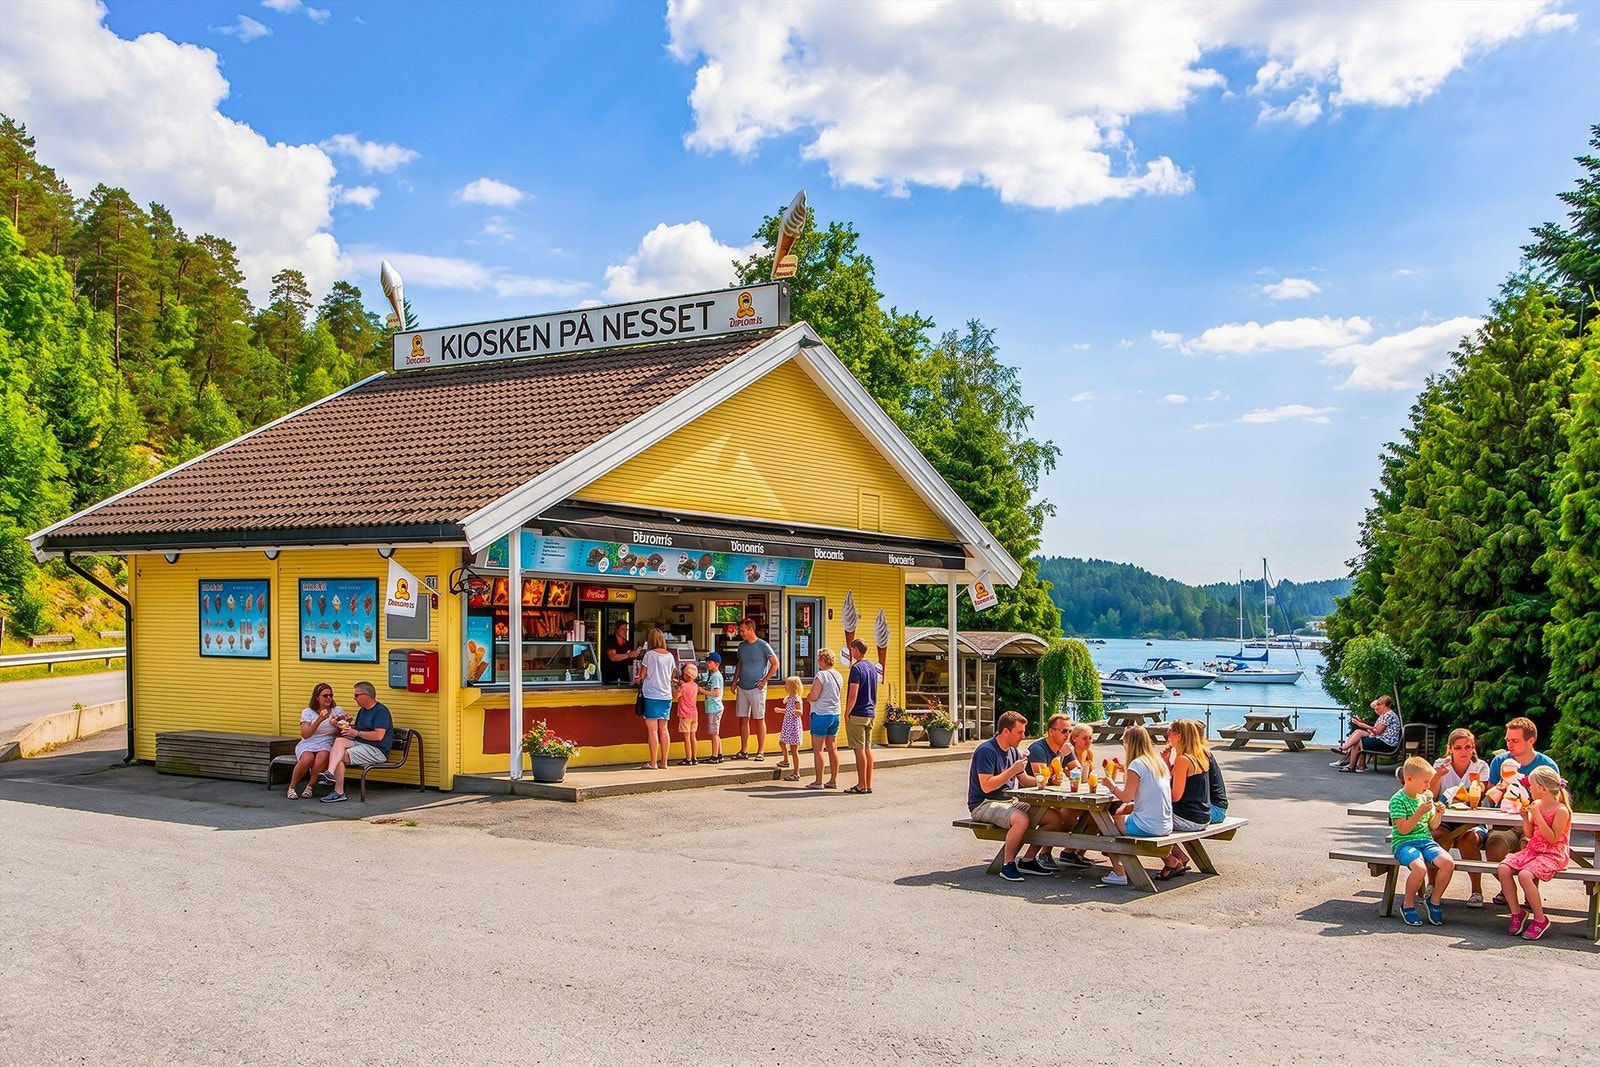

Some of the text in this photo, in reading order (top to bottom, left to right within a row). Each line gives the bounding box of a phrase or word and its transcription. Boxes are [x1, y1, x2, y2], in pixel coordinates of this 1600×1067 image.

[441, 300, 716, 361] KIOSKEN PÅ NESSET
